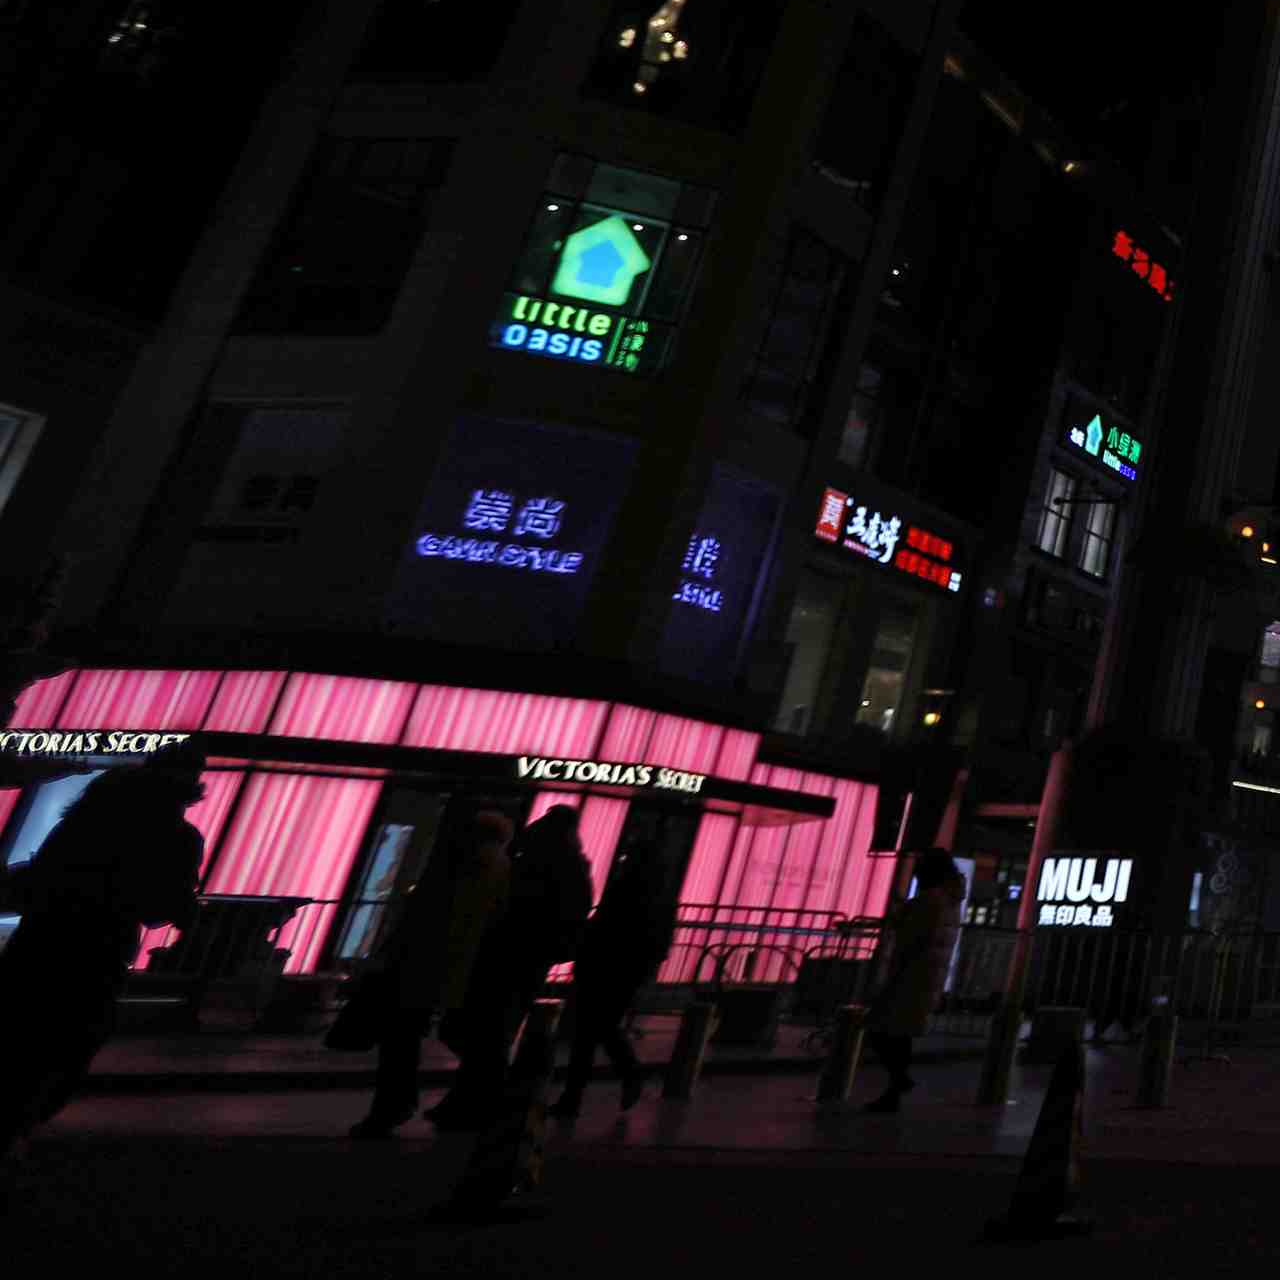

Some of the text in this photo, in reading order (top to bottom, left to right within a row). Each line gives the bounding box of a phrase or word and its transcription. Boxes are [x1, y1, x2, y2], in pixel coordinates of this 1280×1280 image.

[0, 731, 101, 754] CTORIA'S
[518, 756, 653, 786] VICTORIA'S
[1037, 857, 1133, 903] MUJI
[1038, 903, 1115, 928] 無印良品
